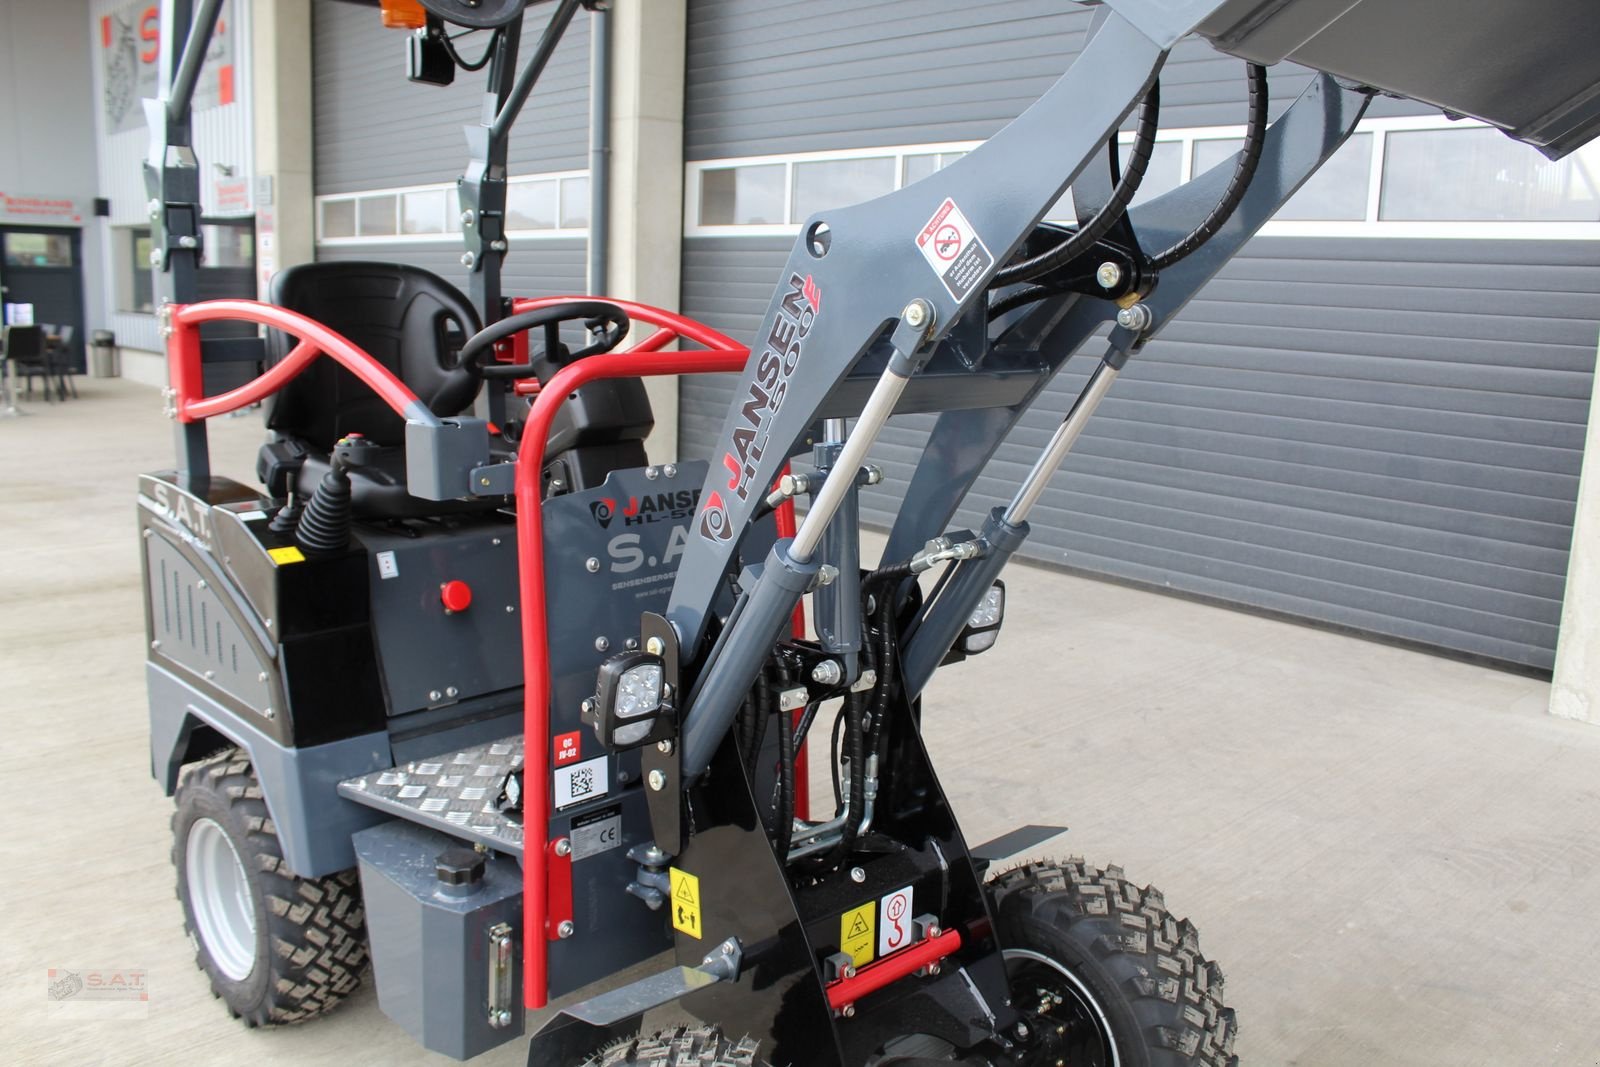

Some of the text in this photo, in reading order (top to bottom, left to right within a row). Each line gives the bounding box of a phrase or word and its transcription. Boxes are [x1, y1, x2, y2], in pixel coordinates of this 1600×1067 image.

[929, 205, 951, 232] ACHTUNG
[954, 242, 977, 271] Aufenthalt
[954, 254, 977, 281] unter dem
[956, 257, 981, 287] Hubarm ist
[962, 265, 983, 289] verboten
[723, 271, 807, 493] JANSEN
[600, 827, 615, 843] CE
